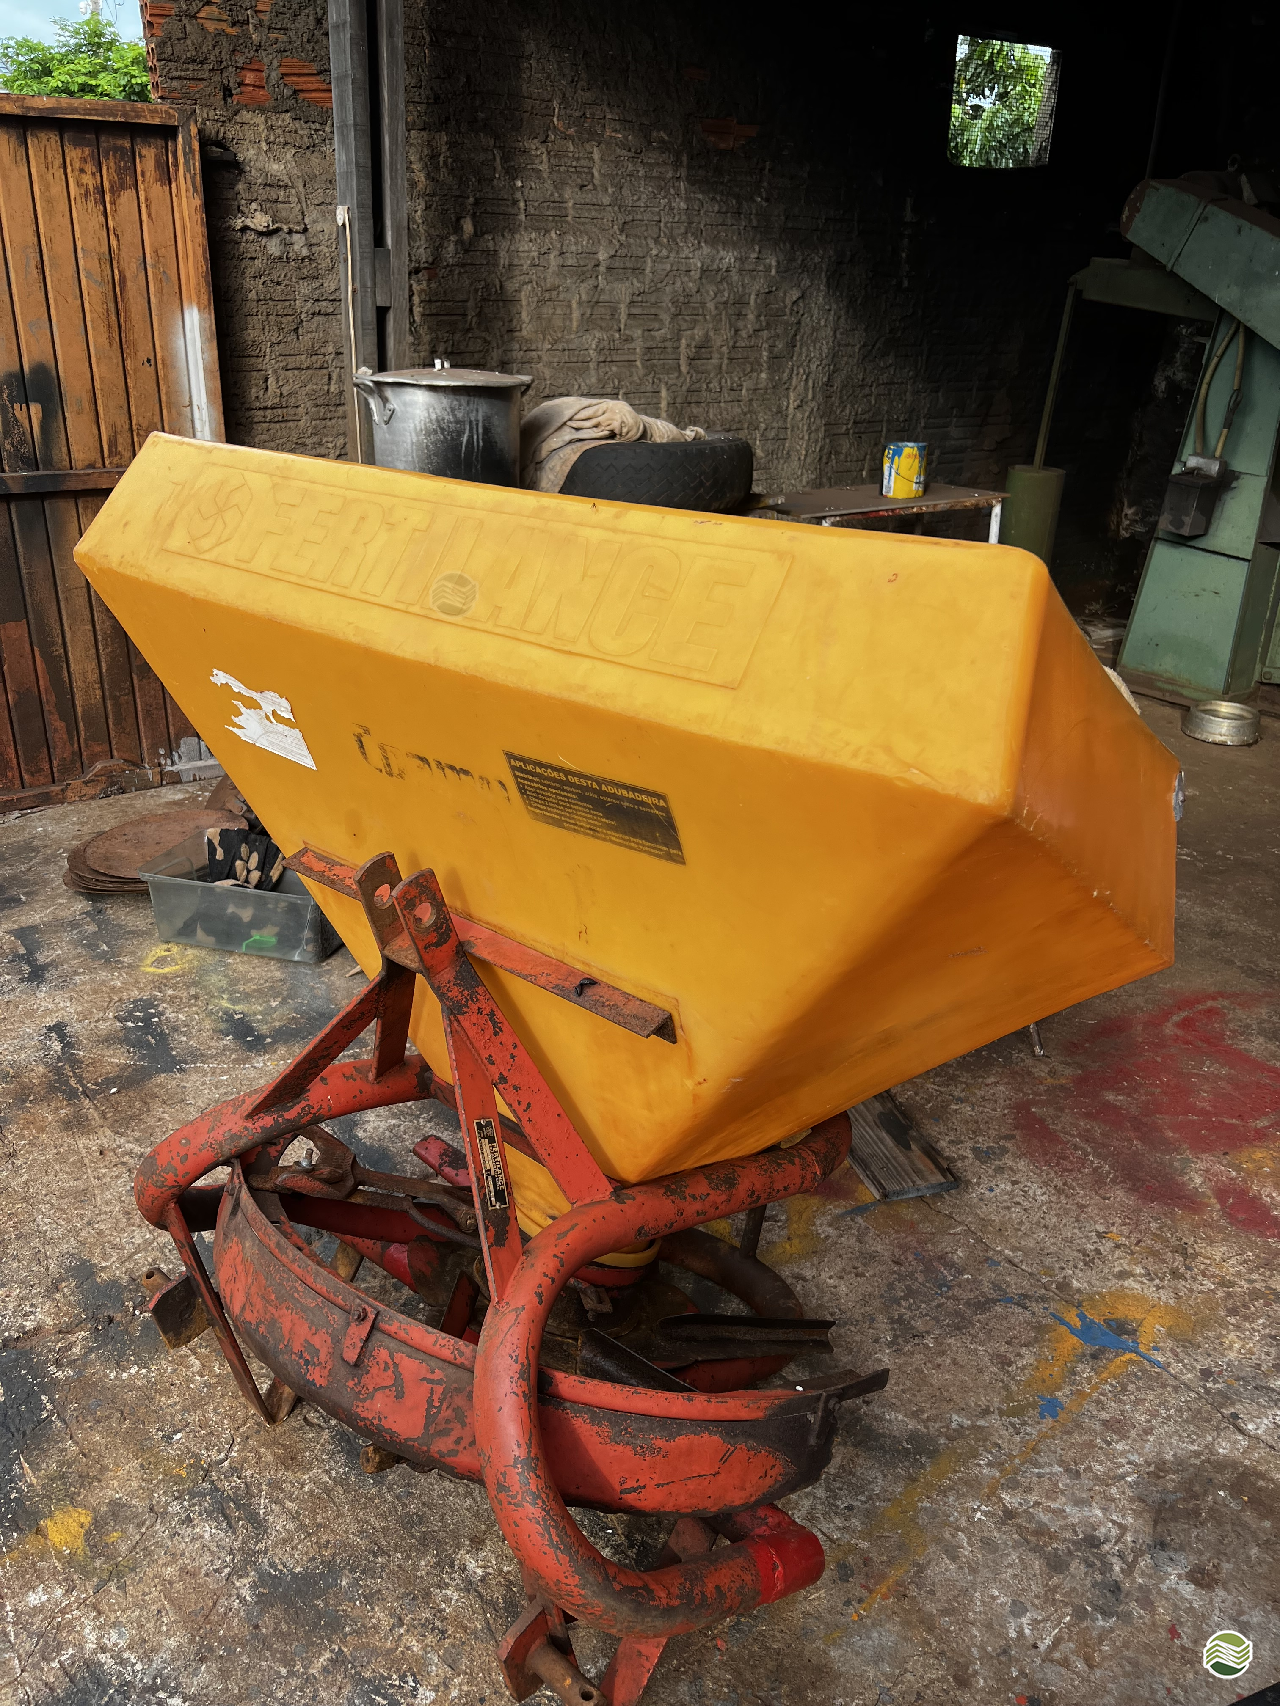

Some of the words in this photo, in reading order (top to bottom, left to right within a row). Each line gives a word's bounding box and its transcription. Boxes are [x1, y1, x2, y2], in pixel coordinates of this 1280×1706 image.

[234, 491, 756, 671] FERTILANCE
[510, 758, 567, 781] APLICAÇÕES
[568, 775, 600, 791] DESTA
[601, 785, 667, 807] ADUBADEIRA
